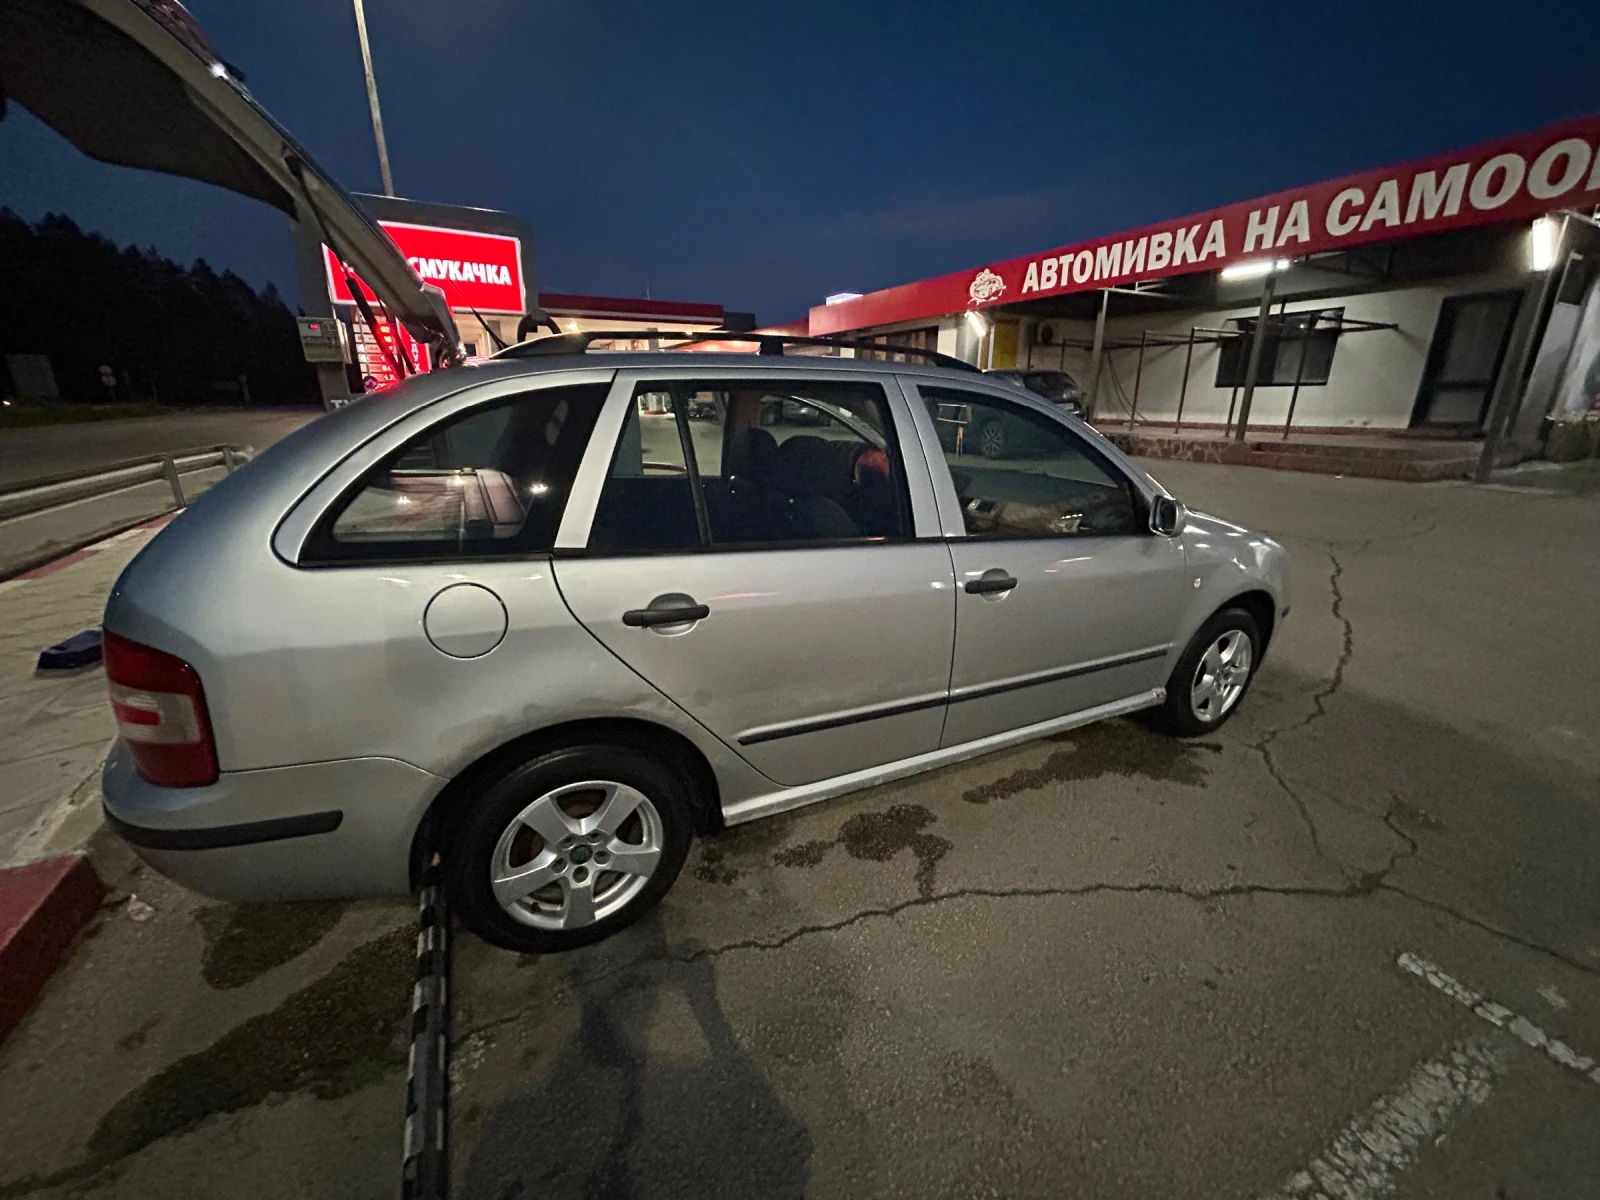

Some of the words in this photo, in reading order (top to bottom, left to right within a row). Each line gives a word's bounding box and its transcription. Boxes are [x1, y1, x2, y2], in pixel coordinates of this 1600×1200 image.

[1021, 219, 1227, 294] АВТОМИВКА
[1242, 199, 1311, 253] НА
[1325, 137, 1600, 237] САМОО
